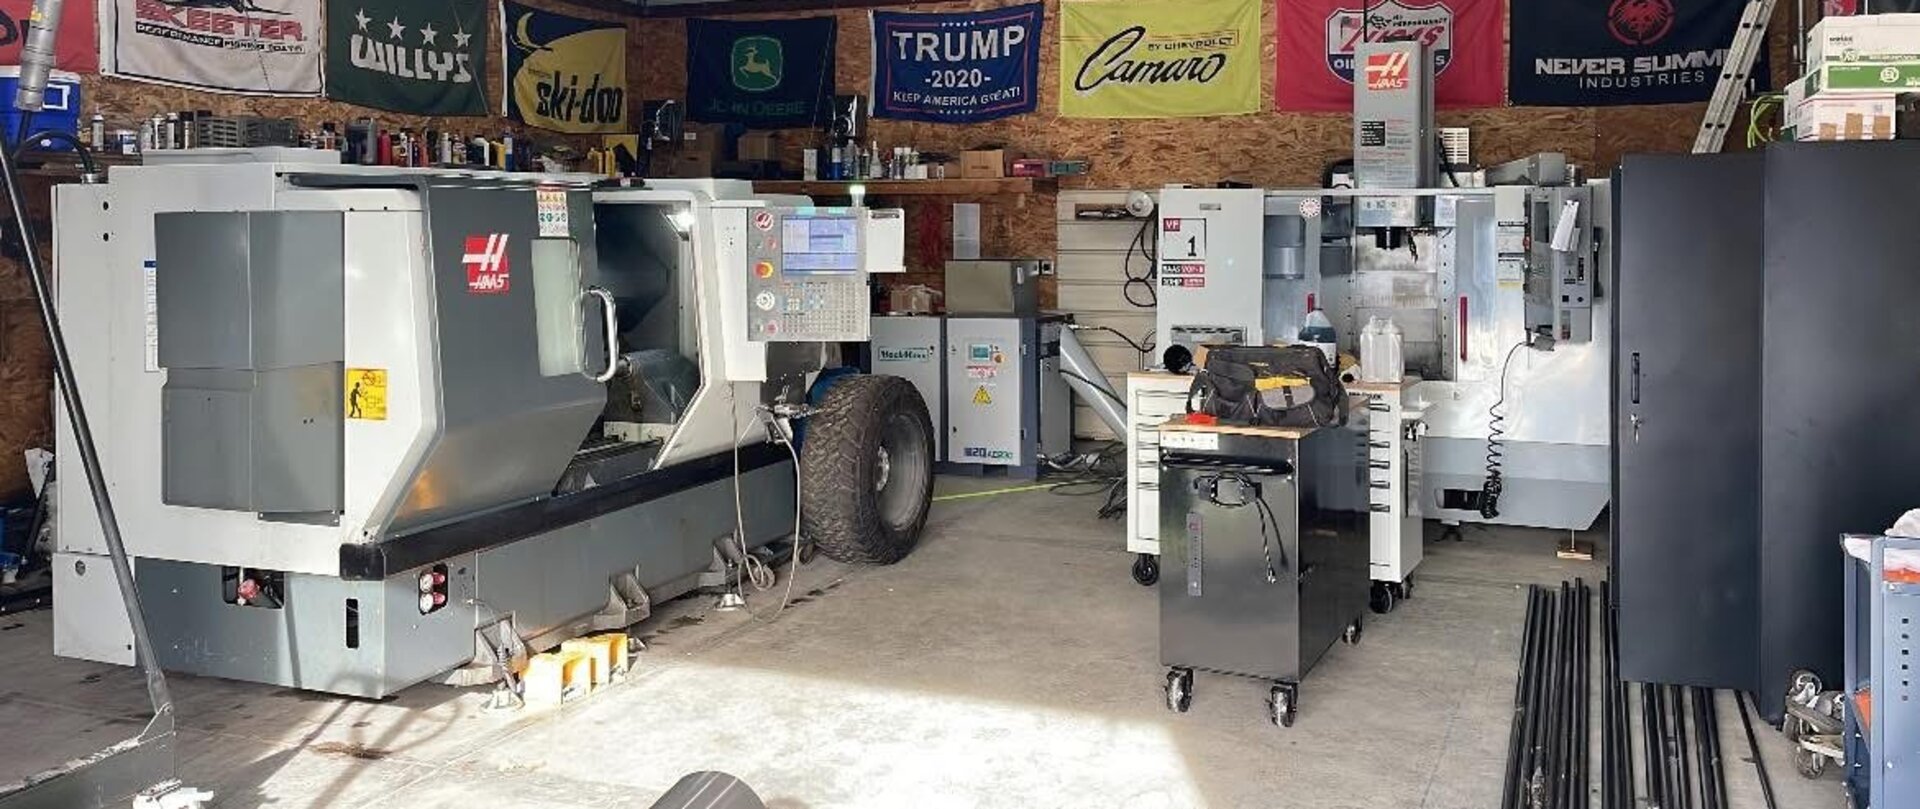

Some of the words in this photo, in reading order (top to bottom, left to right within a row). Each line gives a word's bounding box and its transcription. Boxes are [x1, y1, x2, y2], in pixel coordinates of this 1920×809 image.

[136, 0, 303, 42] SKEETER
[892, 25, 1026, 62] TRUMP
[1148, 43, 1161, 51] BY
[1165, 37, 1233, 50] CHEVROLET
[350, 34, 472, 82] WILLYS
[1074, 26, 1226, 91] Camaro
[1535, 58, 1626, 75] NEVER
[1632, 49, 1734, 72] SUMM
[1368, 78, 1411, 89] HAAS
[1579, 71, 1705, 89] INDUSTRIES
[893, 91, 921, 104] KEEP
[923, 95, 978, 107] AMERICA
[980, 86, 1021, 105] GREAT!
[1165, 219, 1179, 230] VF
[1187, 235, 1197, 257] 1
[469, 273, 509, 290] HAAS
